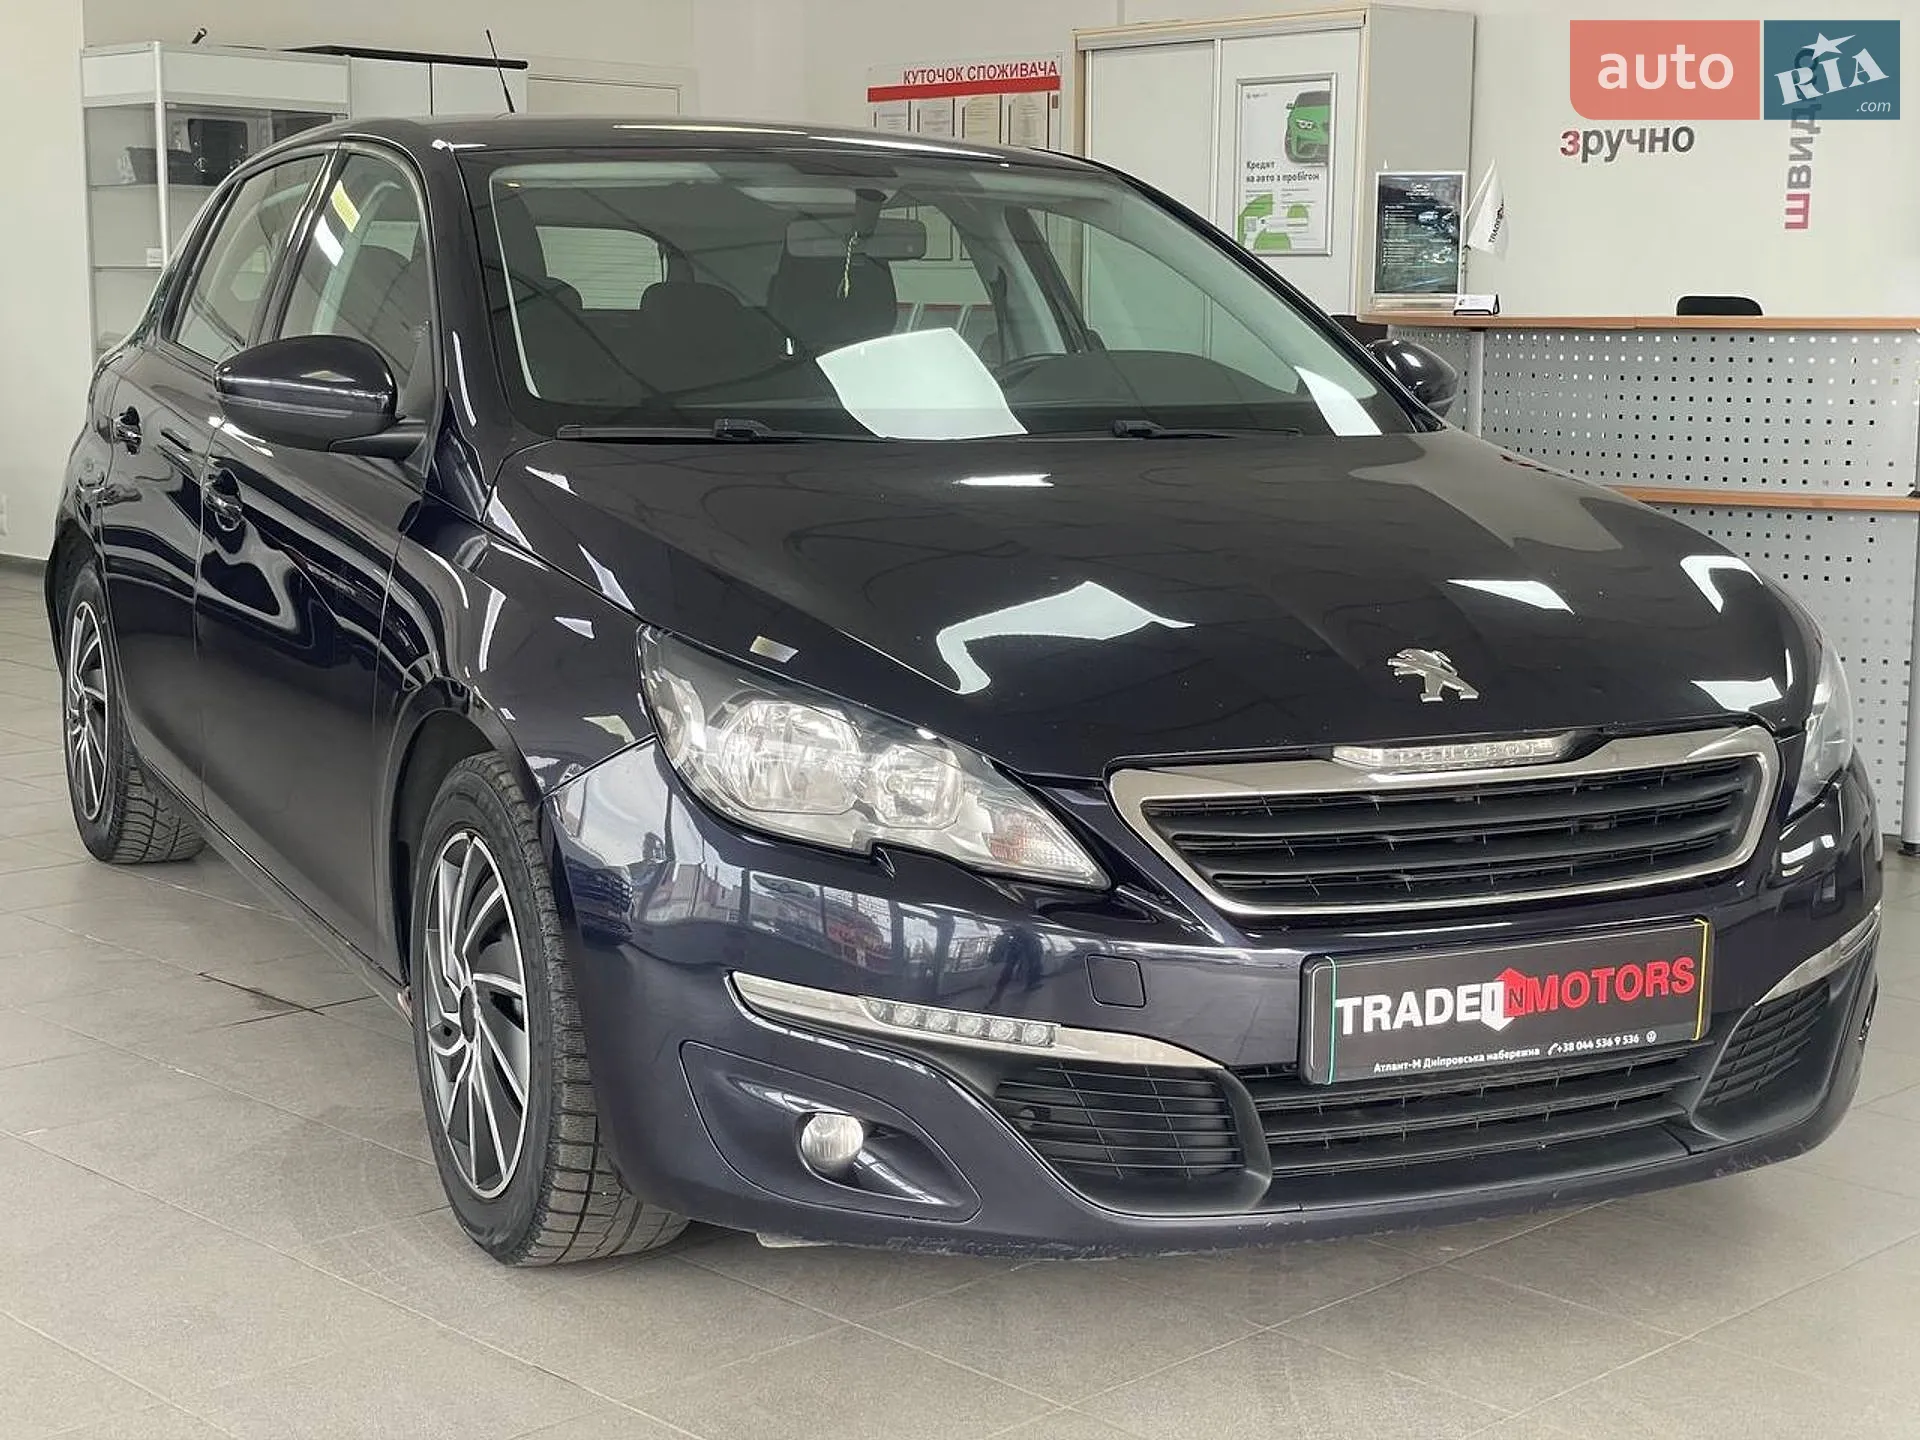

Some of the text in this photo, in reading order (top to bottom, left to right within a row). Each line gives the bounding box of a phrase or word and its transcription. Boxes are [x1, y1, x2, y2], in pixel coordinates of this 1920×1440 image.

[903, 61, 1057, 85] КУТОЧОК СПОЖИВАЧА
[1560, 126, 1695, 163] зручно
[1246, 160, 1275, 170] Кредит
[1256, 174, 1275, 182] авто
[1282, 171, 1320, 184] пробігом
[1398, 741, 1538, 763] PEUGEOT
[1526, 957, 1695, 1013] MOTORS
[1374, 1058, 1421, 1073] Атлант-М
[1423, 1054, 1485, 1069] Дніпровська
[1486, 1048, 1540, 1061] набережна
[1595, 1037, 1613, 1049] 536
[1622, 1033, 1639, 1045] 536
